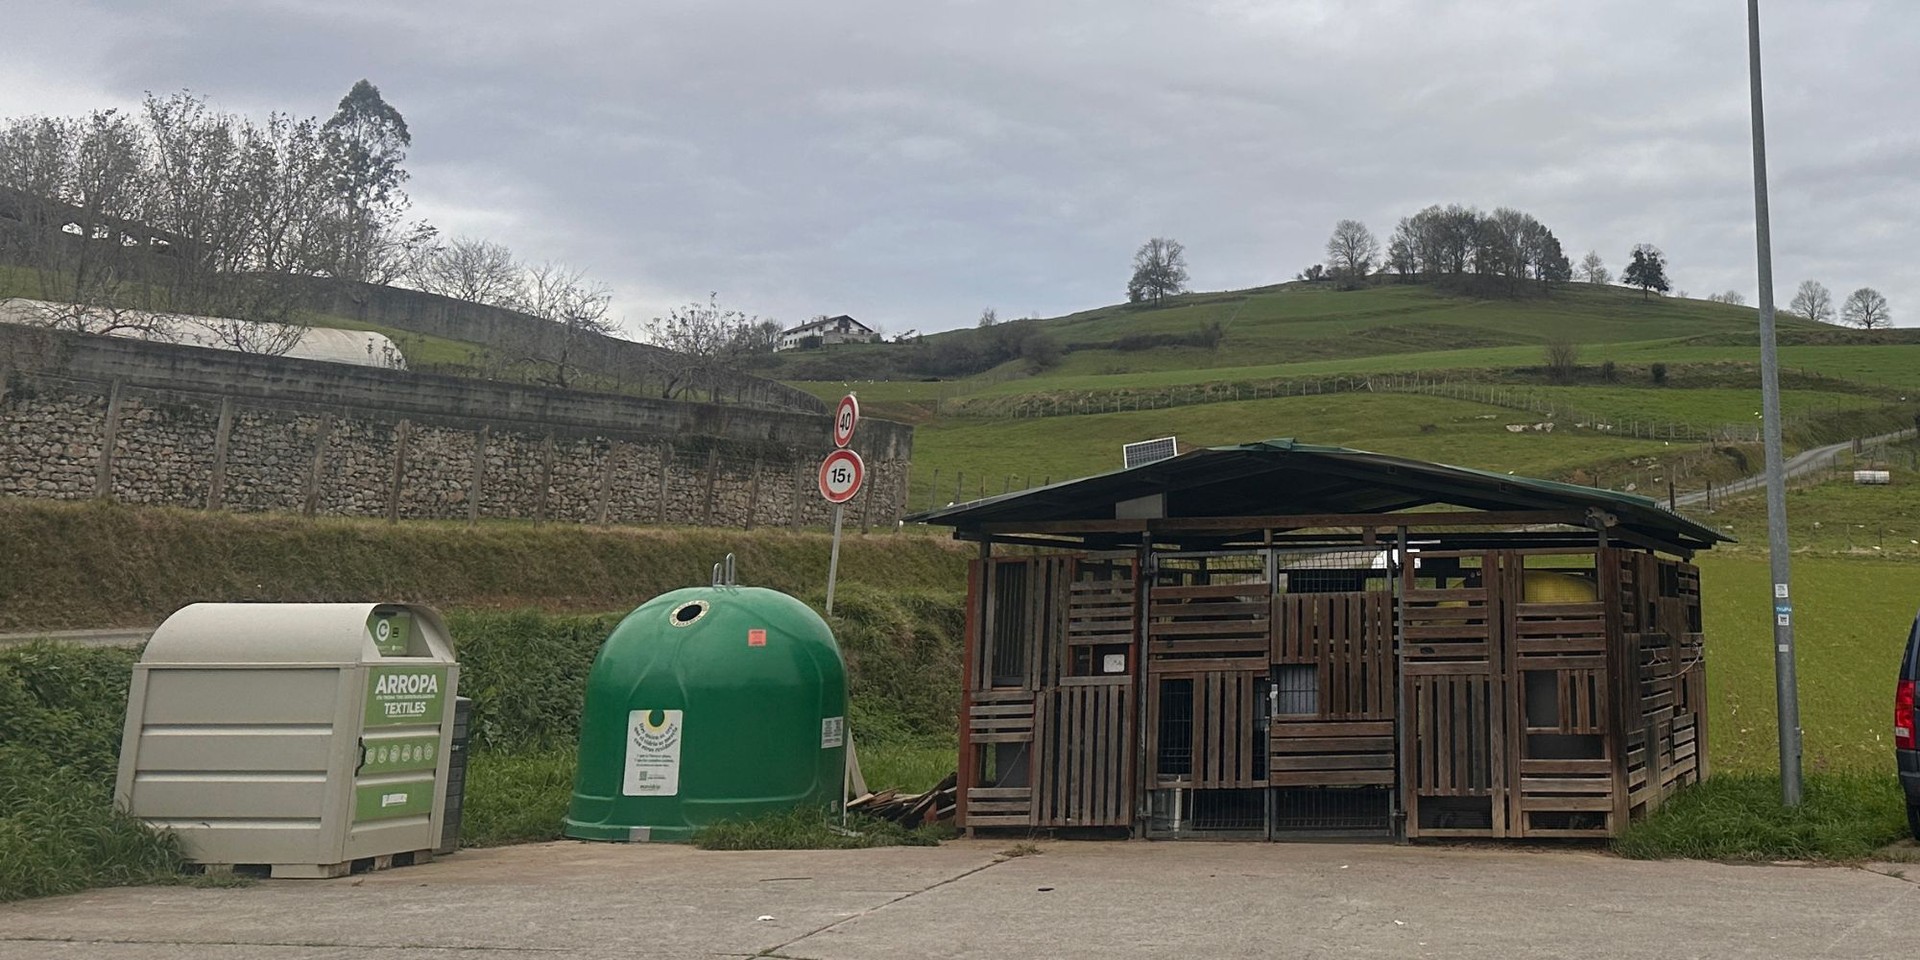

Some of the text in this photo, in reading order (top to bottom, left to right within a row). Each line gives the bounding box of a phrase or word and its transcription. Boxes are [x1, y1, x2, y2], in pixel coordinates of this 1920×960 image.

[839, 412, 851, 431] 40
[375, 674, 438, 694] ARROPA
[384, 702, 426, 715] TEXTILES
